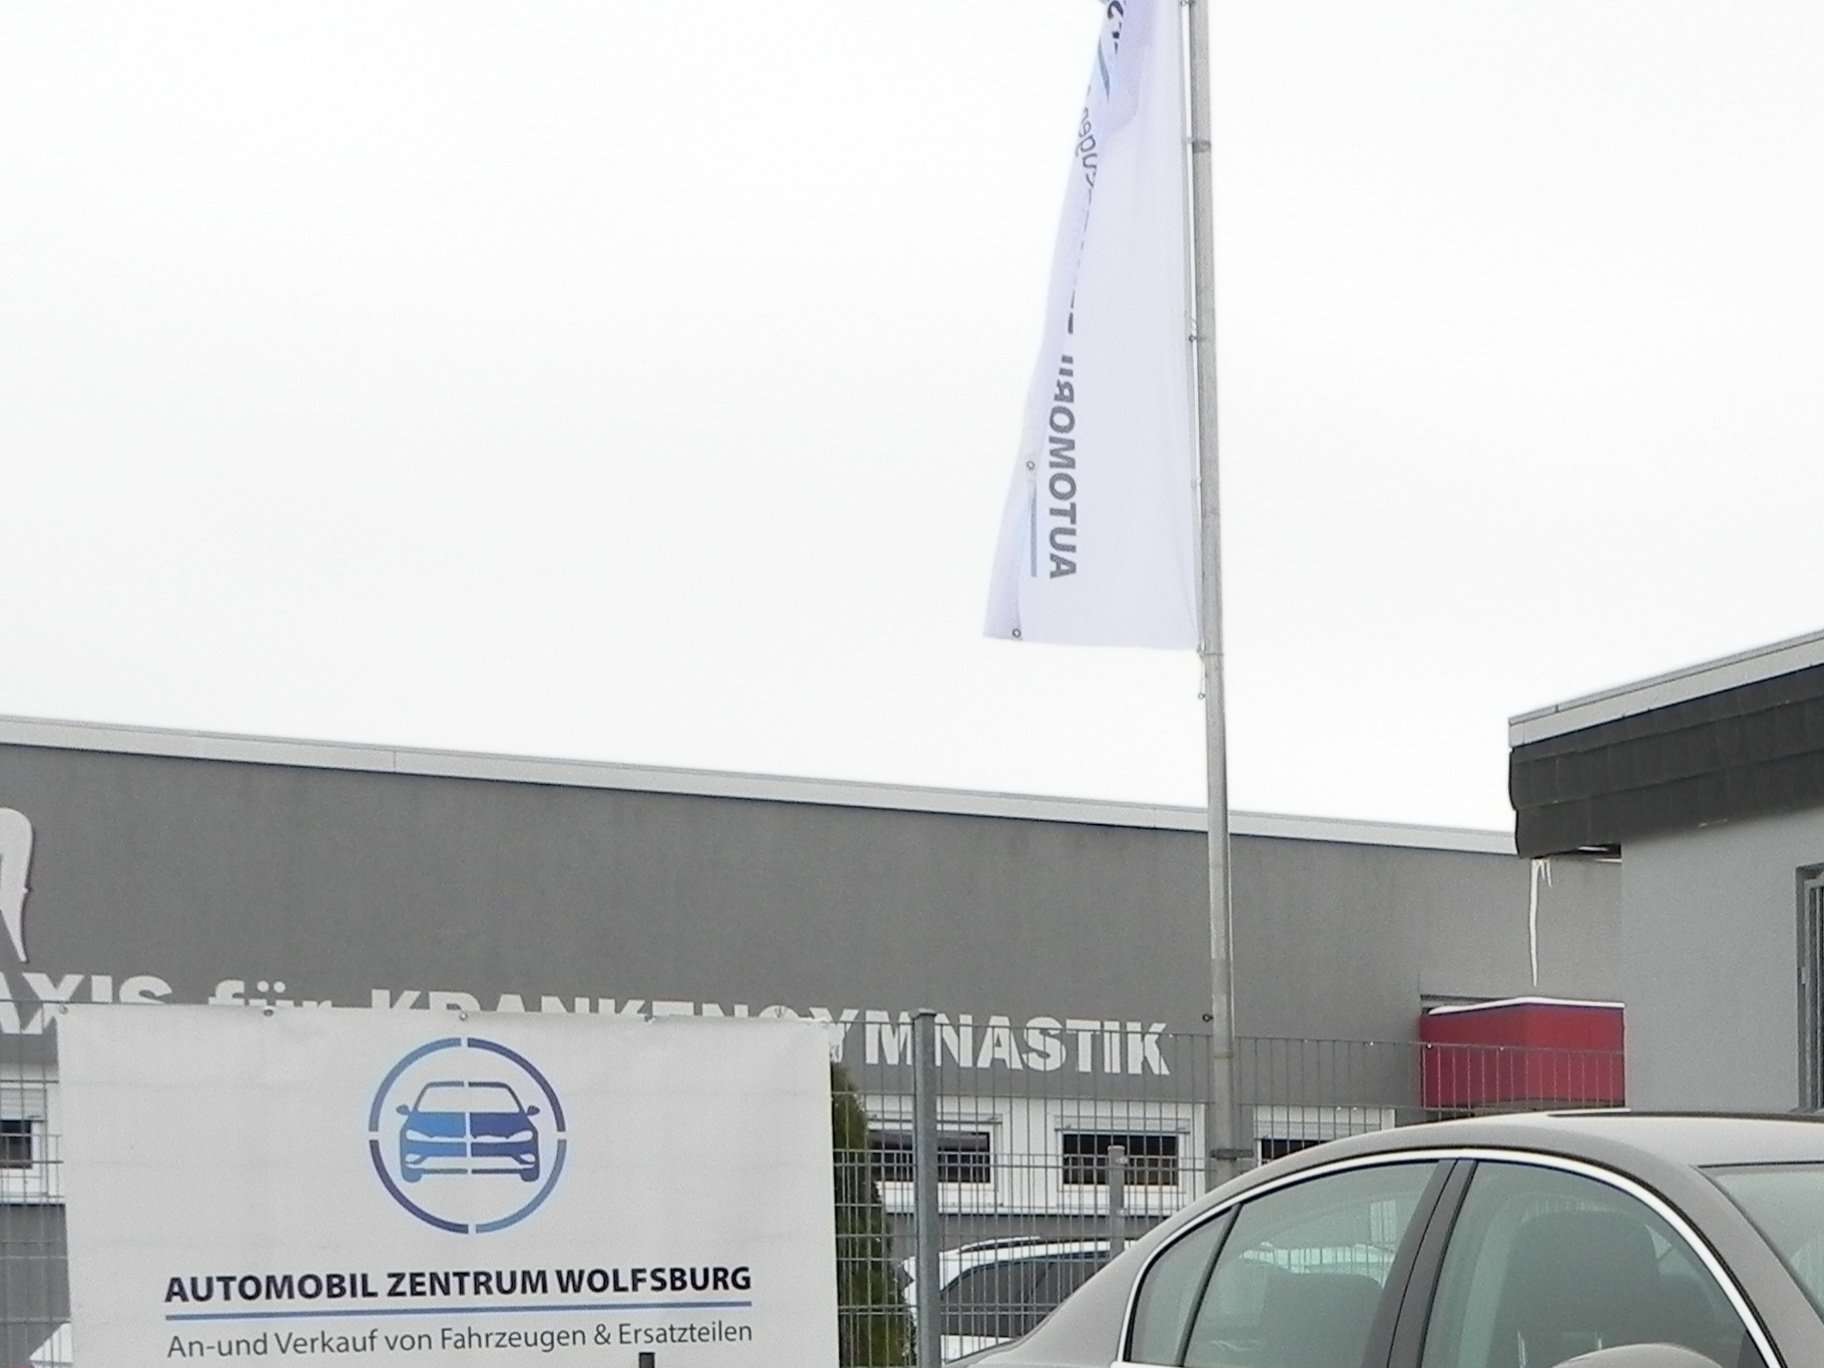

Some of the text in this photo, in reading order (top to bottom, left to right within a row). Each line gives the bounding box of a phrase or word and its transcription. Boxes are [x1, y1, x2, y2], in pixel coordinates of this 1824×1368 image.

[165, 1267, 752, 1303] AUTOMOBIL ZENTRUM WOLFSBURG
[167, 1320, 752, 1358] An-und Verkauf von Fahrzeugen & Ersatzteilen
